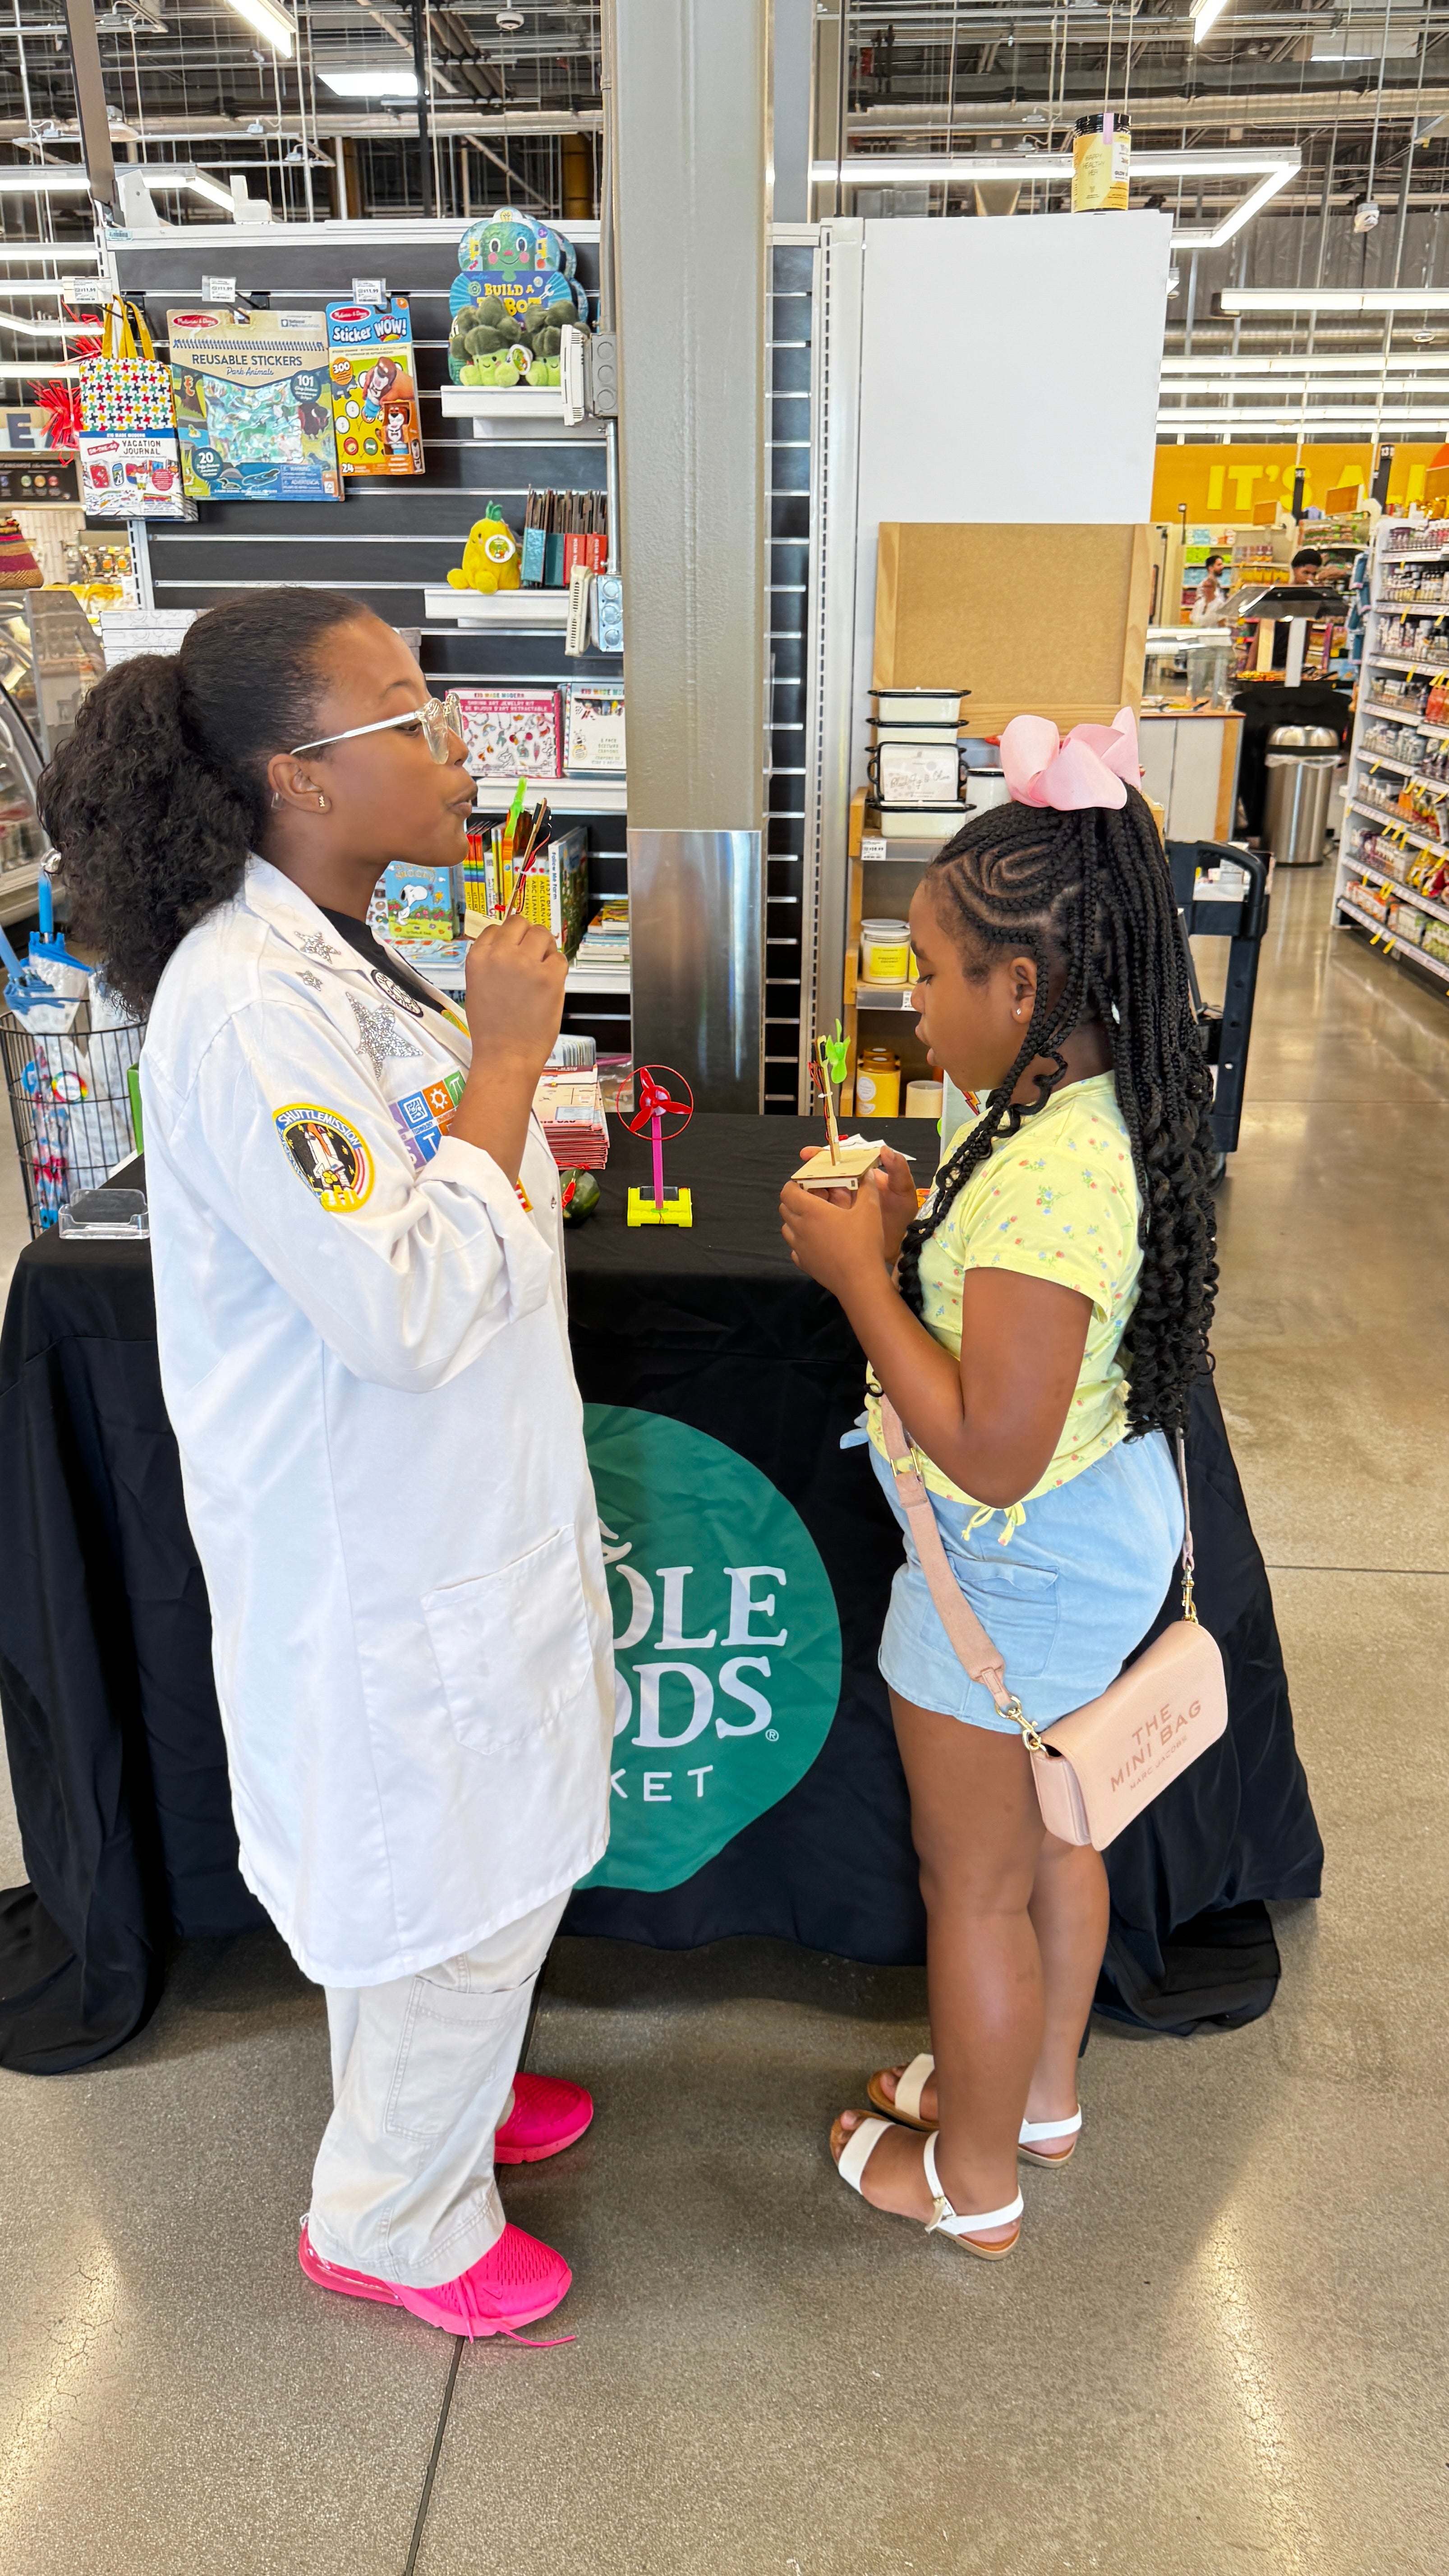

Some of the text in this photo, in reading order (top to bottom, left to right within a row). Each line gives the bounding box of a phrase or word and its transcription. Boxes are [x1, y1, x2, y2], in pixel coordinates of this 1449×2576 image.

[484, 283, 534, 296] BUILD A
[333, 317, 407, 342] Sticker WOW!
[192, 354, 303, 366] REUSABLE STICKERS
[226, 367, 275, 376] Park Animals
[333, 361, 350, 374] 300
[297, 375, 314, 387] 101
[198, 451, 214, 464] 20
[342, 462, 354, 473] 24
[1207, 465, 1313, 511] IT'S
[1132, 1703, 1172, 1746] THE
[1110, 1700, 1201, 1793] MINI BAG
[611, 1764, 714, 1802] KET
[1130, 1767, 1154, 1791] MARC
